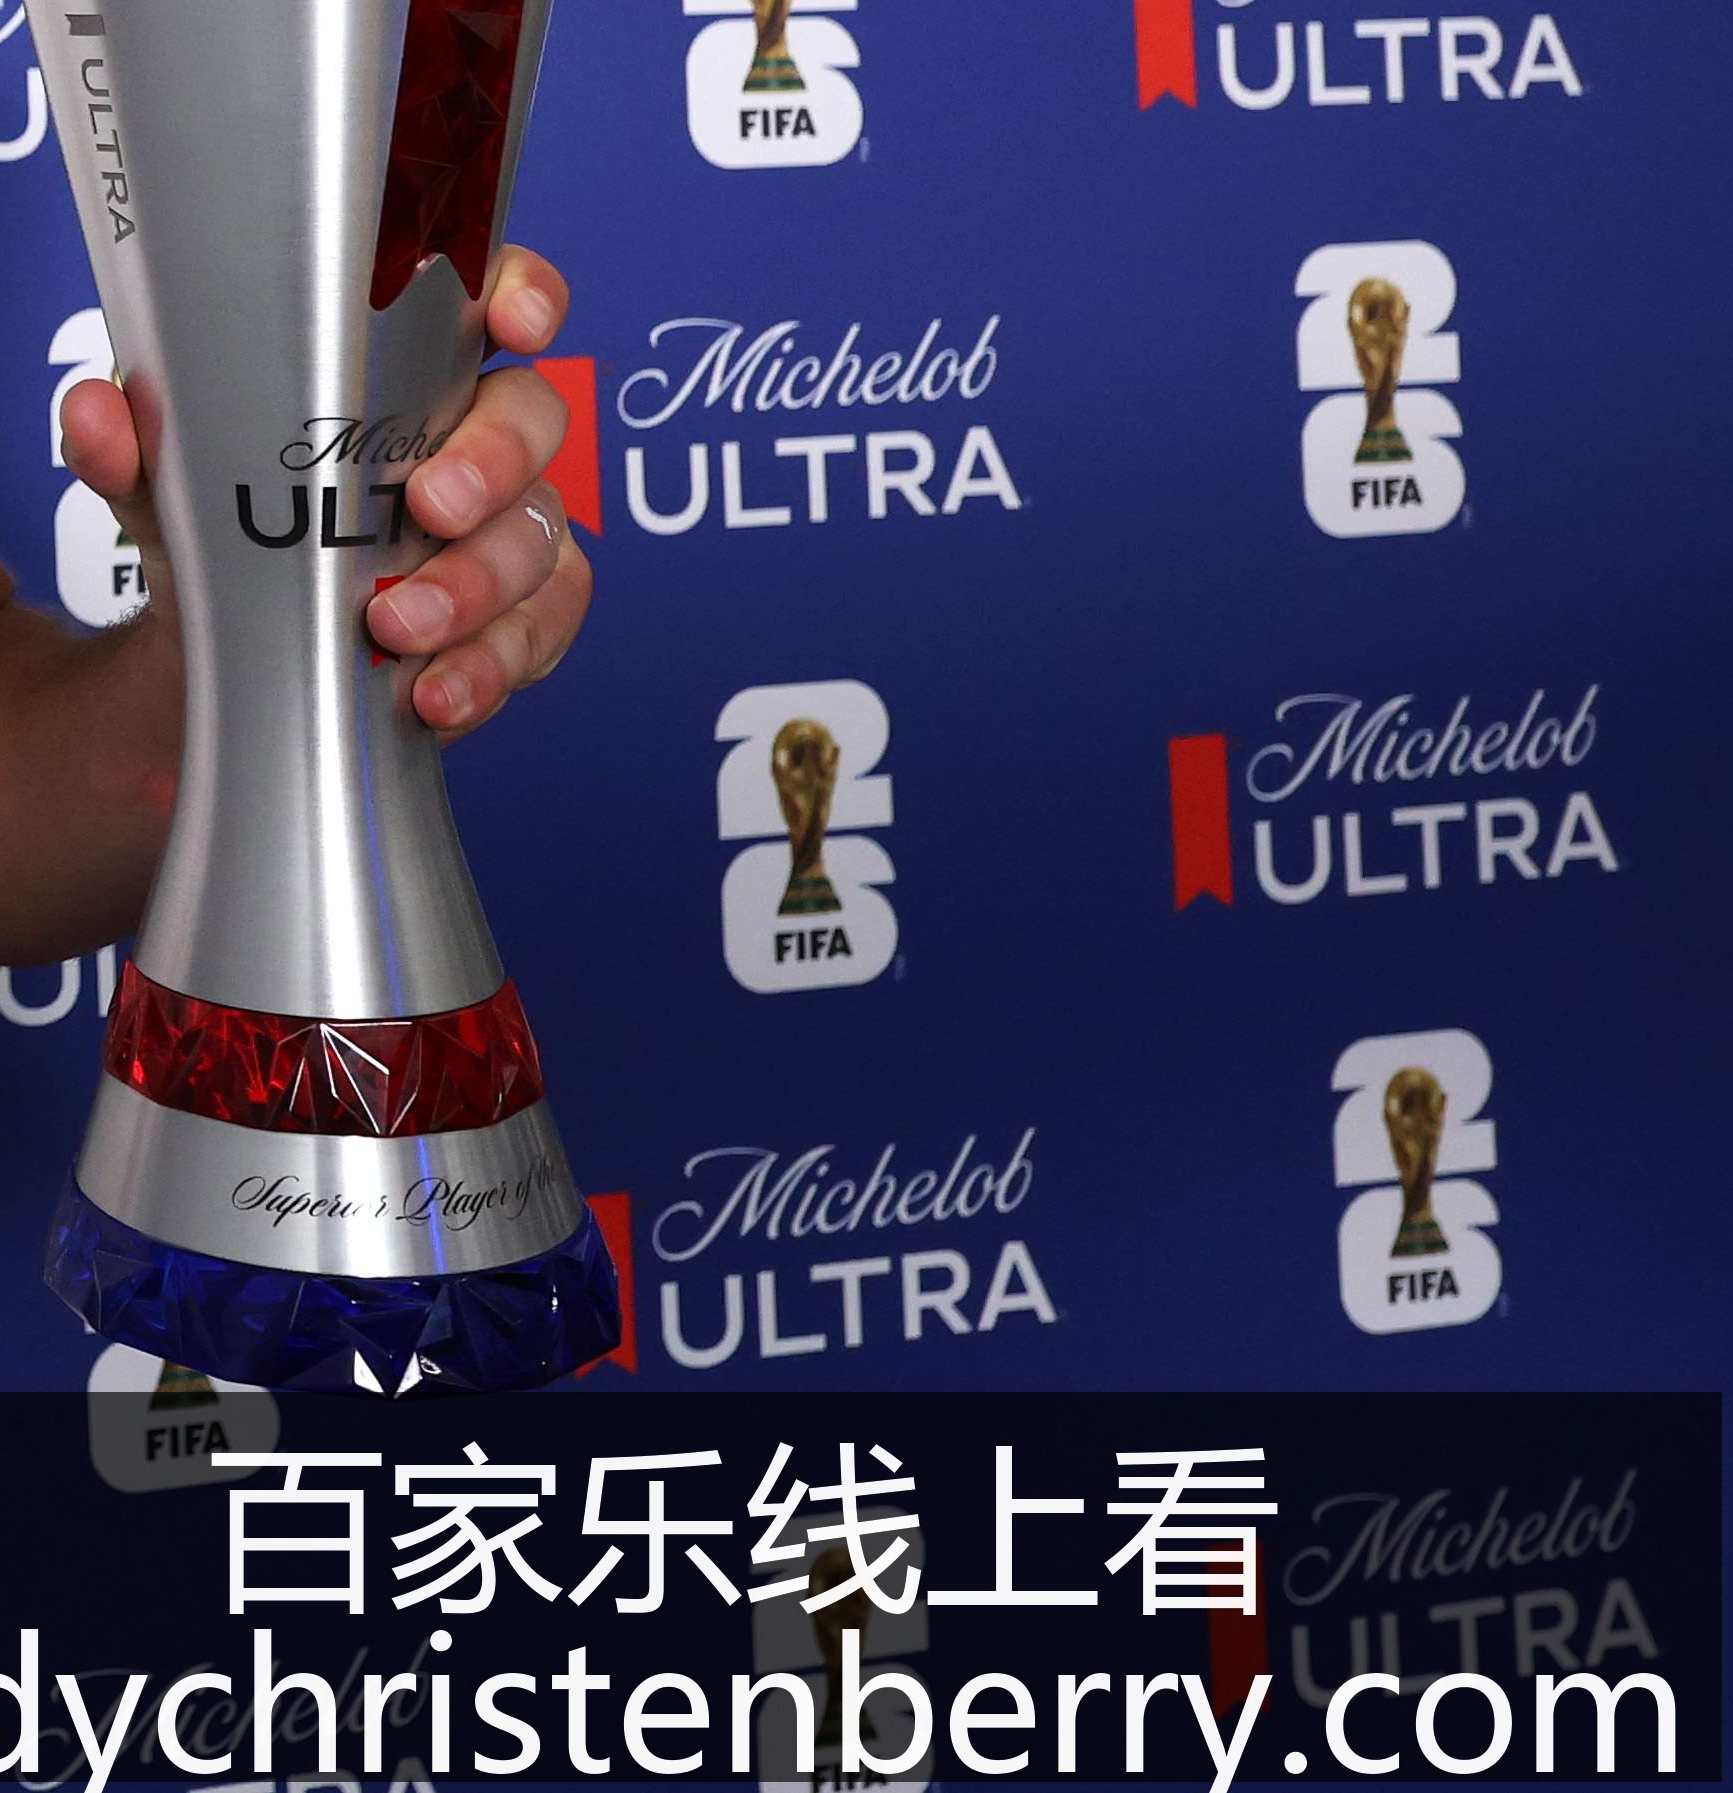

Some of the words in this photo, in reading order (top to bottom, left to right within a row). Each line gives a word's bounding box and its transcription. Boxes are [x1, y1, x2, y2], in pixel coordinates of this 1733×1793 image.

[1217, 15, 1583, 110] ULTRA
[81, 58, 137, 244] ULTRA
[741, 108, 815, 137] FIFA
[617, 315, 999, 428] Michelob
[235, 482, 407, 549] ULT
[625, 426, 1021, 535] ULTRA
[1352, 478, 1422, 508] FIFA
[1247, 684, 1597, 802] Michelob
[1254, 792, 1618, 904] ULTRA
[775, 927, 852, 963] FIFA
[396, 1176, 507, 1231] Player
[653, 1128, 1035, 1261] Michelob
[661, 1241, 1057, 1368] ULTRA
[1389, 1270, 1458, 1303] FIFA
[146, 1421, 230, 1460] FIFA
